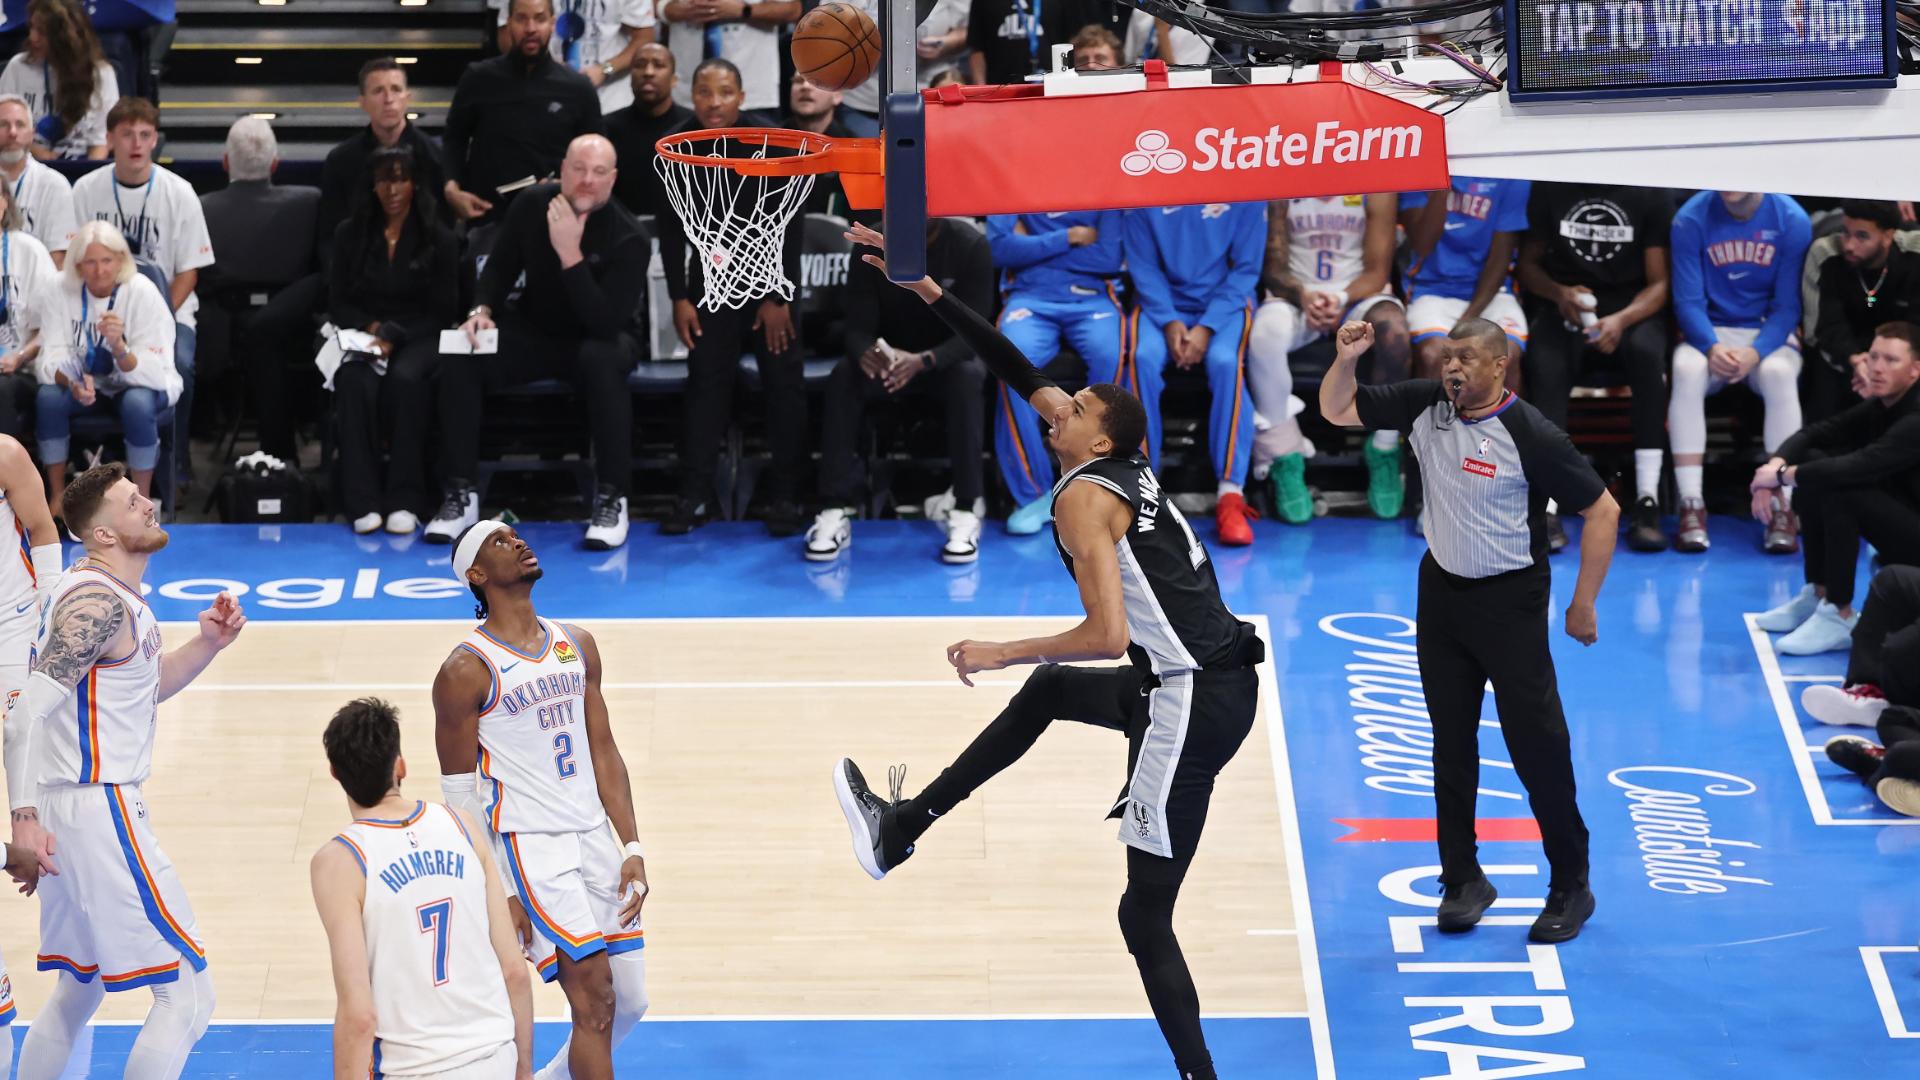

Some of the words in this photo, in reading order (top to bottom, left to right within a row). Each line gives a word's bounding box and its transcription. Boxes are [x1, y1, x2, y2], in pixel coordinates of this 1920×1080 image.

[1538, 3, 1593, 51] TAP
[1604, 1, 1644, 49] TO
[1653, 0, 1762, 47] WATCH
[800, 253, 851, 287] YOFFS
[1315, 249, 1334, 281] 6
[1707, 240, 1775, 268] THUNDER
[1463, 460, 1495, 476] Emirates
[140, 568, 465, 609] ogle
[501, 671, 586, 716] OKLAHOM
[537, 699, 575, 731] CITY
[553, 731, 577, 780] 2
[379, 849, 465, 894] HOLMGREN
[416, 897, 453, 987] 7
[1378, 864, 1586, 1080] ULTRA
